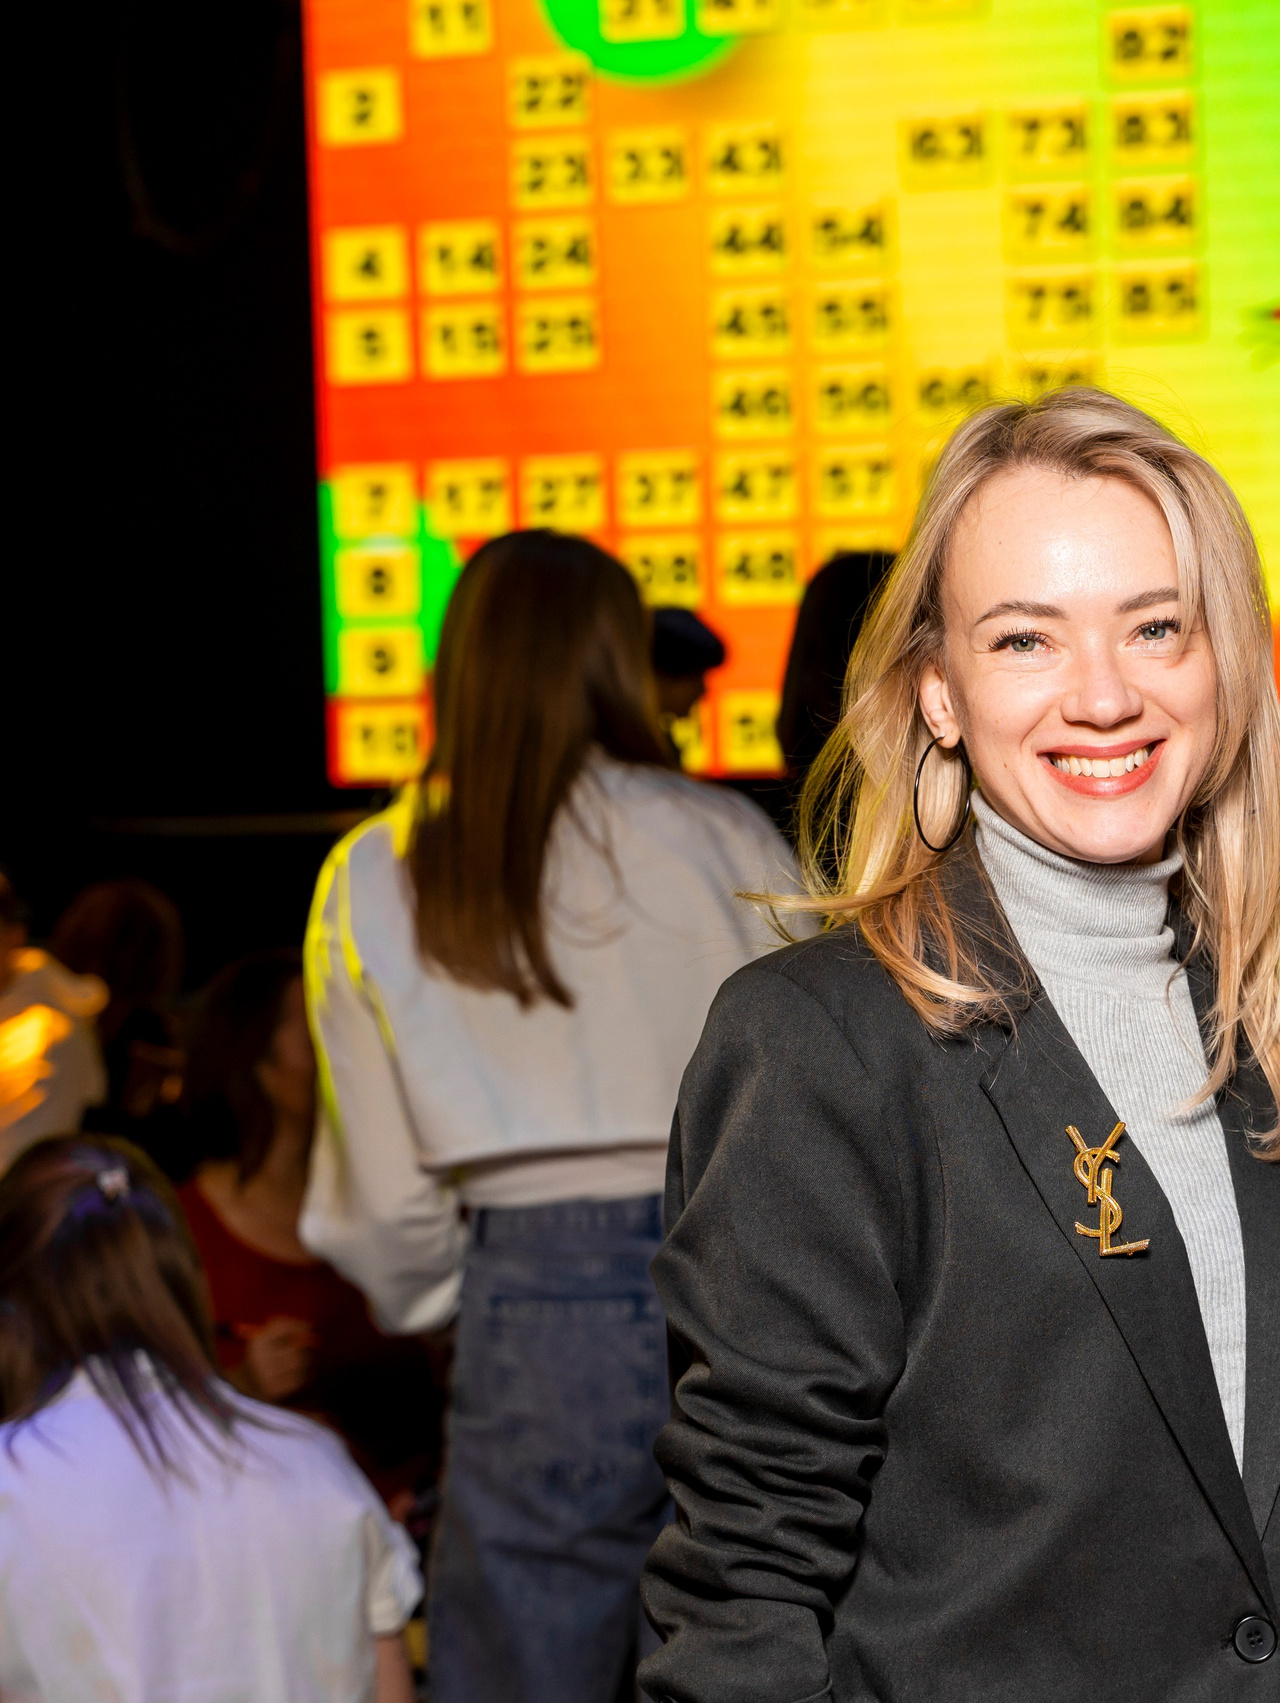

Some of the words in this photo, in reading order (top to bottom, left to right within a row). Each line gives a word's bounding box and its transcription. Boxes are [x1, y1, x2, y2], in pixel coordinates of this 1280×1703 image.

[349, 88, 378, 129] 2
[523, 71, 590, 112] 22
[1114, 23, 1188, 64] 82
[524, 153, 591, 195] 23
[623, 145, 686, 184] 33
[712, 139, 781, 176] 43
[909, 123, 984, 163] 63
[1015, 116, 1089, 153] 73
[1117, 108, 1192, 149] 83
[354, 250, 384, 281] 4
[436, 240, 498, 278] 14
[529, 235, 592, 275] 24
[715, 222, 784, 257] 44
[815, 215, 884, 249] 54
[1019, 200, 1089, 236] 74
[1119, 193, 1193, 232] 84
[532, 315, 598, 355] 25
[718, 303, 788, 339] 45
[1020, 284, 1093, 320] 75
[1122, 278, 1197, 317] 85
[721, 386, 791, 420] 46
[820, 380, 890, 414] 56
[364, 480, 392, 517] 7
[444, 477, 503, 513] 17
[536, 473, 601, 513] 27
[633, 469, 695, 508] 37
[721, 464, 791, 502] 47
[822, 458, 892, 498] 57
[364, 564, 395, 599] 8
[725, 549, 795, 583] 48
[367, 643, 399, 678] 9
[1064, 1121, 1151, 1257] YSL
